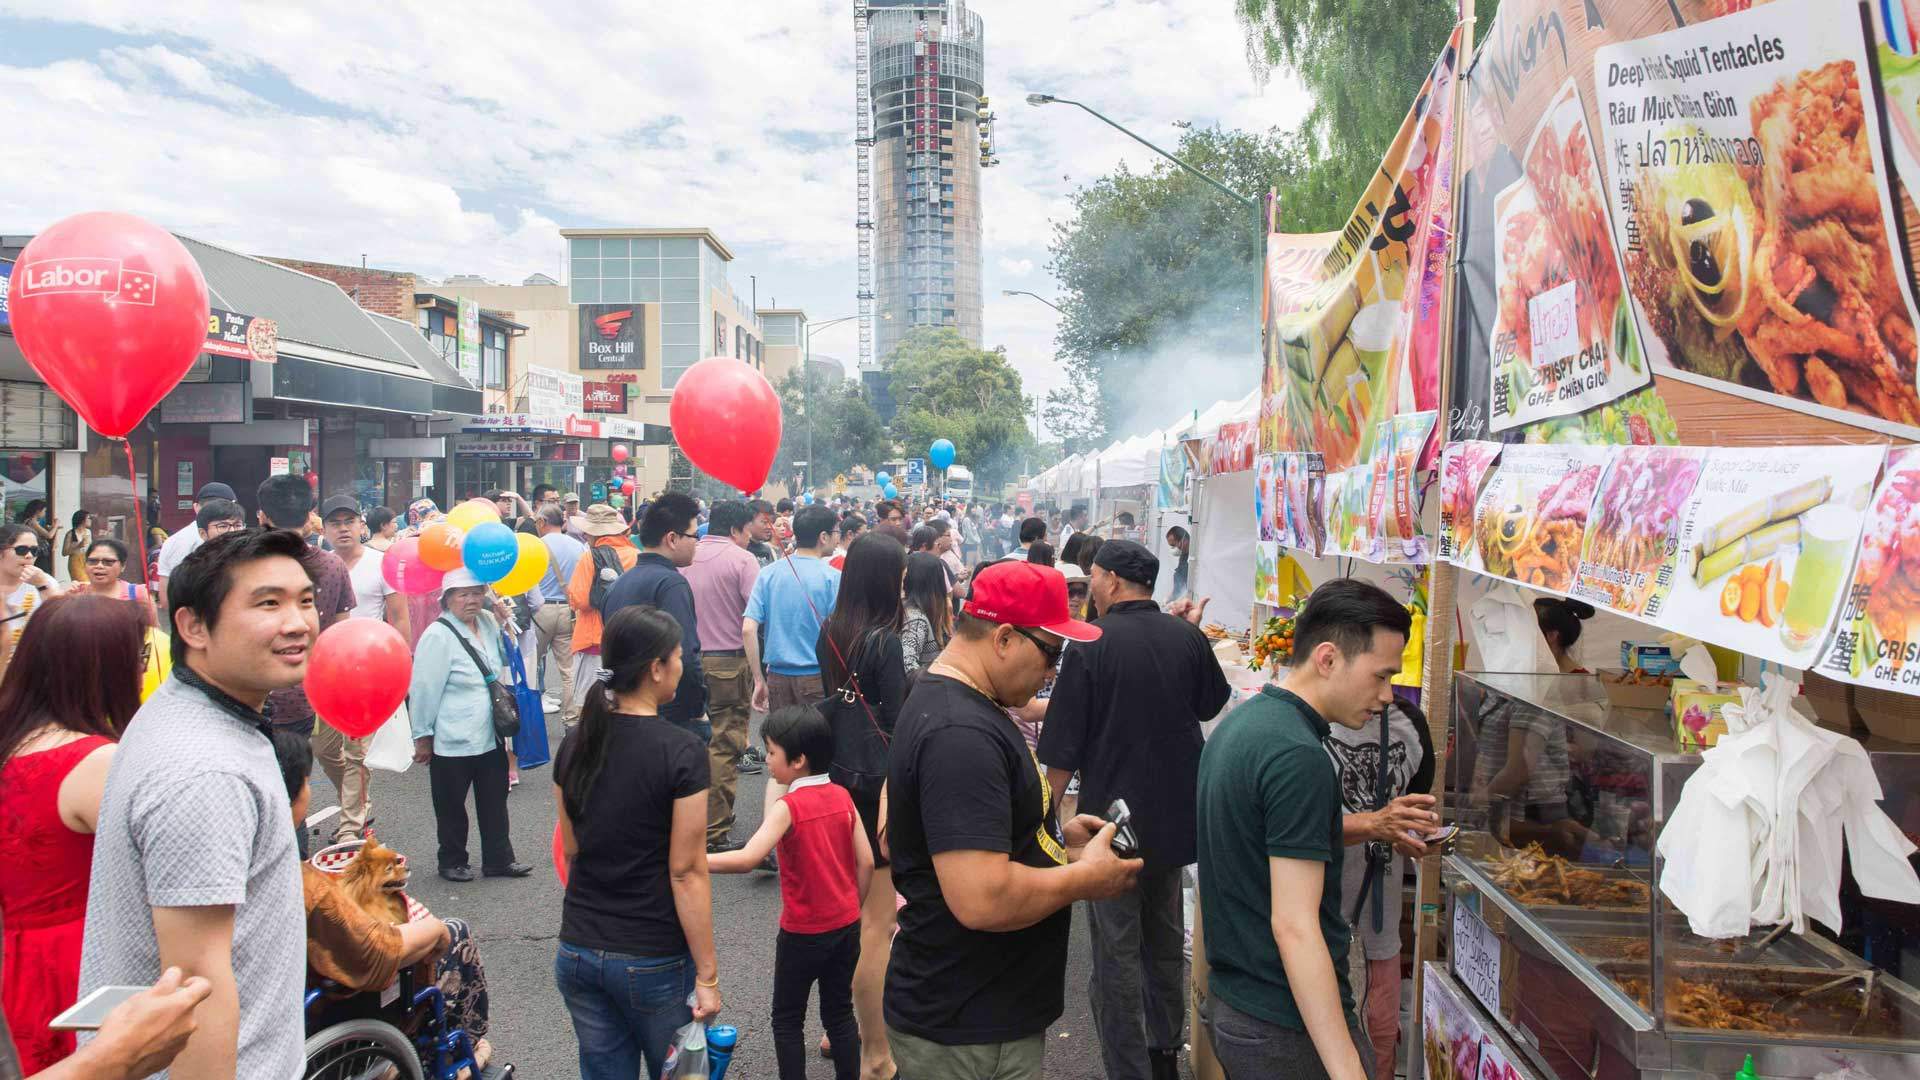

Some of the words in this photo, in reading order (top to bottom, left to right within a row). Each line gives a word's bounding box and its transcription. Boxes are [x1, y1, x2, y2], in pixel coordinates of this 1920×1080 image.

[1608, 63, 1644, 87] Deep
[1642, 56, 1668, 80] Fried
[1665, 48, 1701, 83] Squid
[1700, 34, 1785, 74] Tentacles
[1609, 100, 1636, 125] Râu
[1703, 90, 1738, 118] Giòn
[28, 266, 109, 289] Labor
[589, 342, 611, 353] Box
[616, 342, 634, 353] Hill
[598, 354, 625, 362] Central
[1530, 355, 1574, 387] CRISPY
[1877, 639, 1920, 662] CRIS
